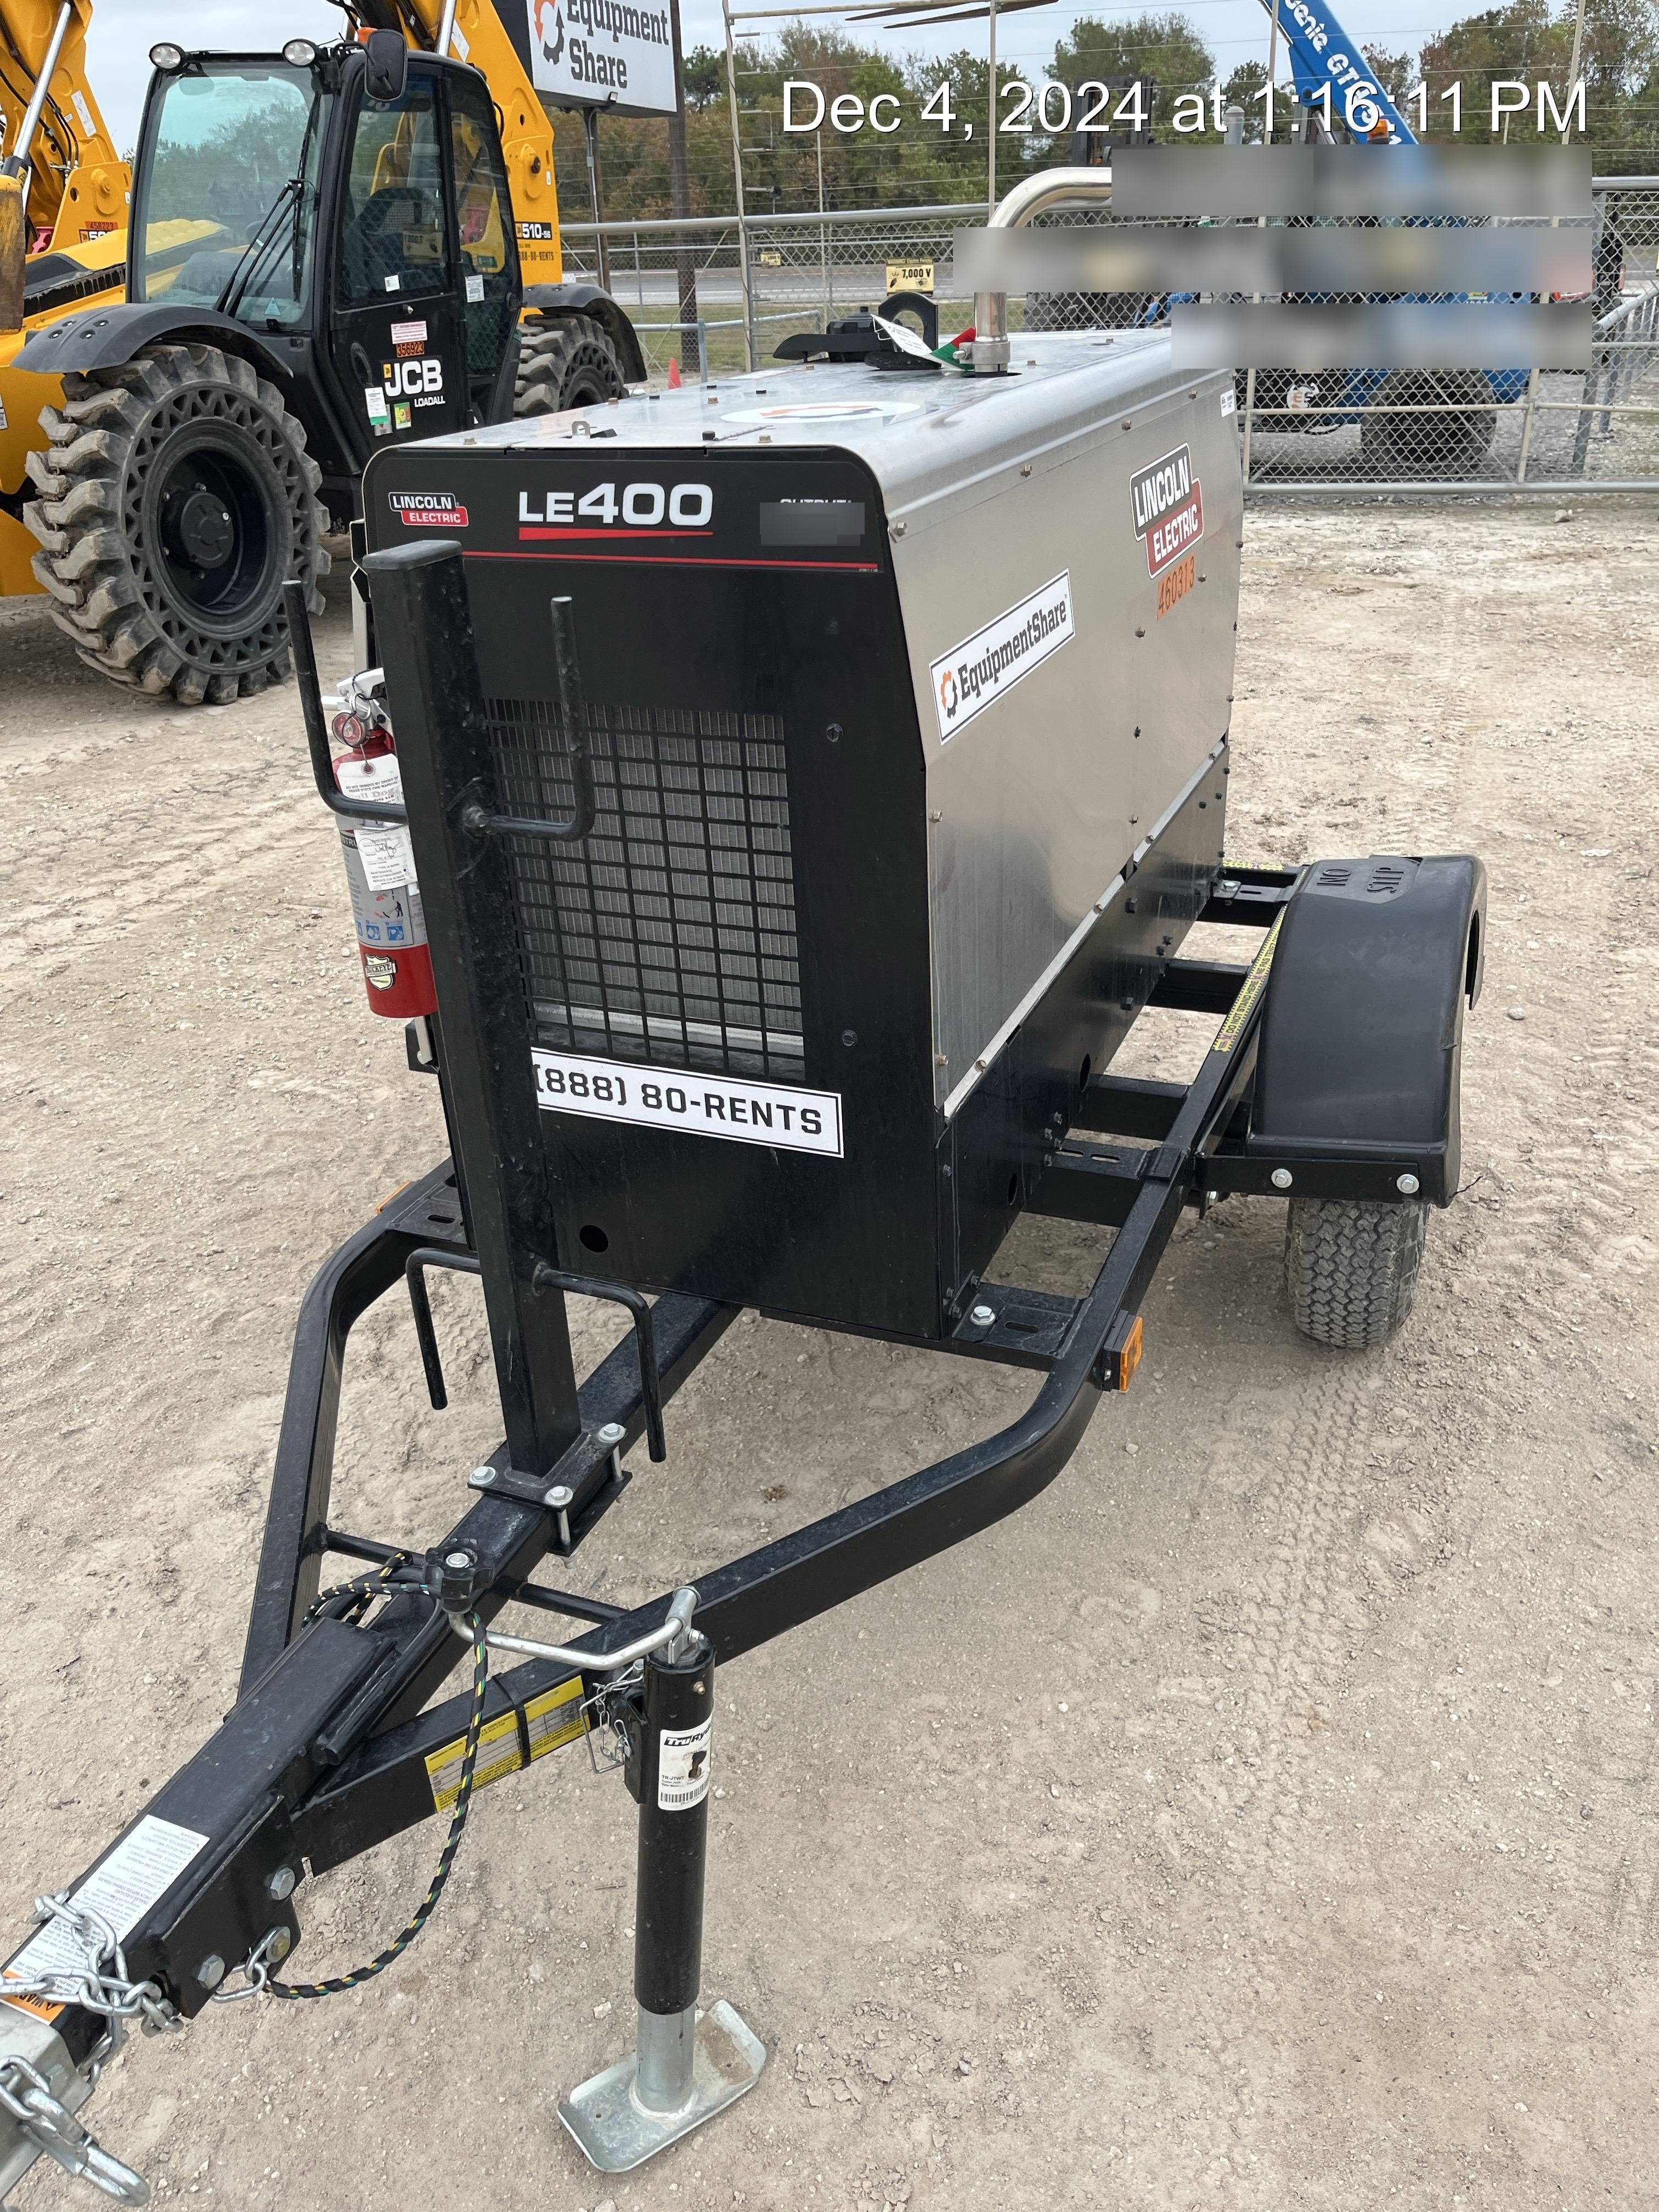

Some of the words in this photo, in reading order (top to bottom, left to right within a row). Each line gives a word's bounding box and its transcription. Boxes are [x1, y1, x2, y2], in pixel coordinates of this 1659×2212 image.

[567, 0, 669, 46] Equipment
[569, 38, 627, 89] Share
[902, 268, 924, 279] 7,000
[926, 268, 931, 277] V
[397, 341, 424, 356] 356923
[385, 359, 443, 397] JCB
[414, 396, 445, 408] LOADALL
[393, 495, 452, 510] LINCOLN
[519, 483, 713, 526] LE400
[1133, 455, 1189, 528] LINCOLN
[409, 512, 461, 523] ELECTRIC
[1153, 504, 1198, 563] ELECTRIC
[1158, 555, 1194, 614] 460313
[958, 600, 1066, 702] EquipmentShare
[1317, 868, 1352, 887] NO
[1366, 867, 1405, 894] SLIP
[1226, 1025, 1235, 1034] DO
[1231, 1014, 1240, 1027] NOT
[1236, 995, 1251, 1014] STAND
[1245, 980, 1259, 997] HERE
[641, 1083, 822, 1135] 80-RENTS
